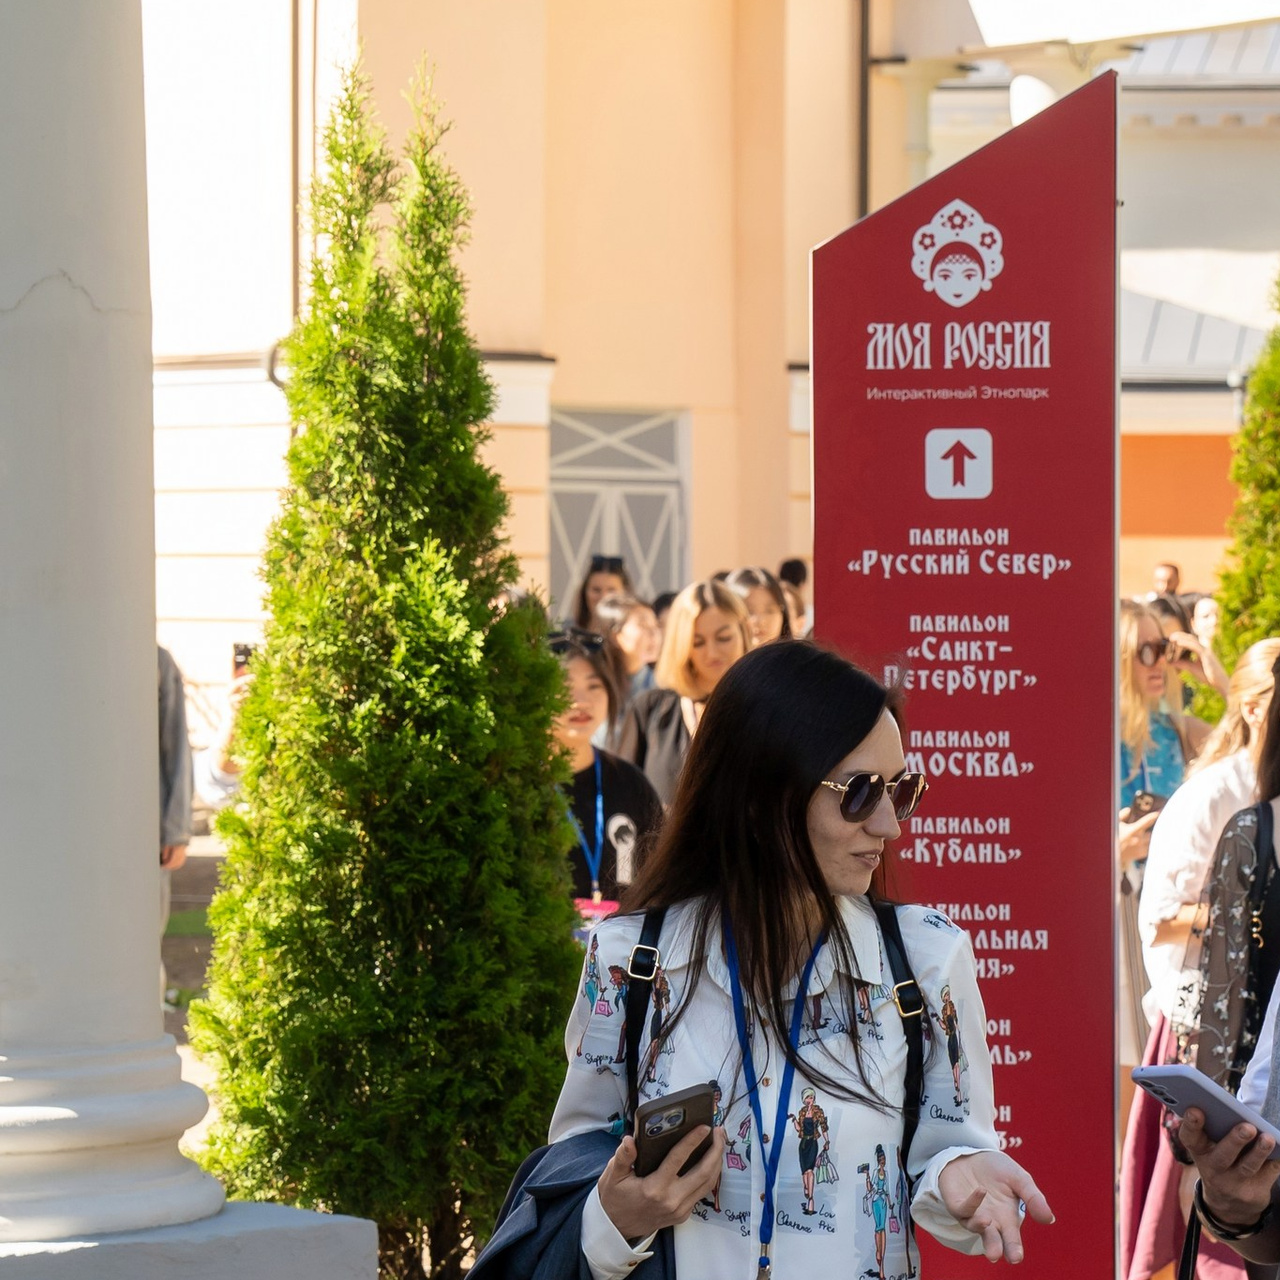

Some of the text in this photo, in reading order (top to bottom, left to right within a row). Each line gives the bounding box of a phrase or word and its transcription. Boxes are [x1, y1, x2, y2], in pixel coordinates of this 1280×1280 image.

[866, 321, 1051, 370] МОЯ РОССИЯ
[866, 386, 1049, 402] Интерактивный Этнопарк
[904, 751, 1034, 778] МОСКВА»
[819, 1204, 836, 1218] Low
